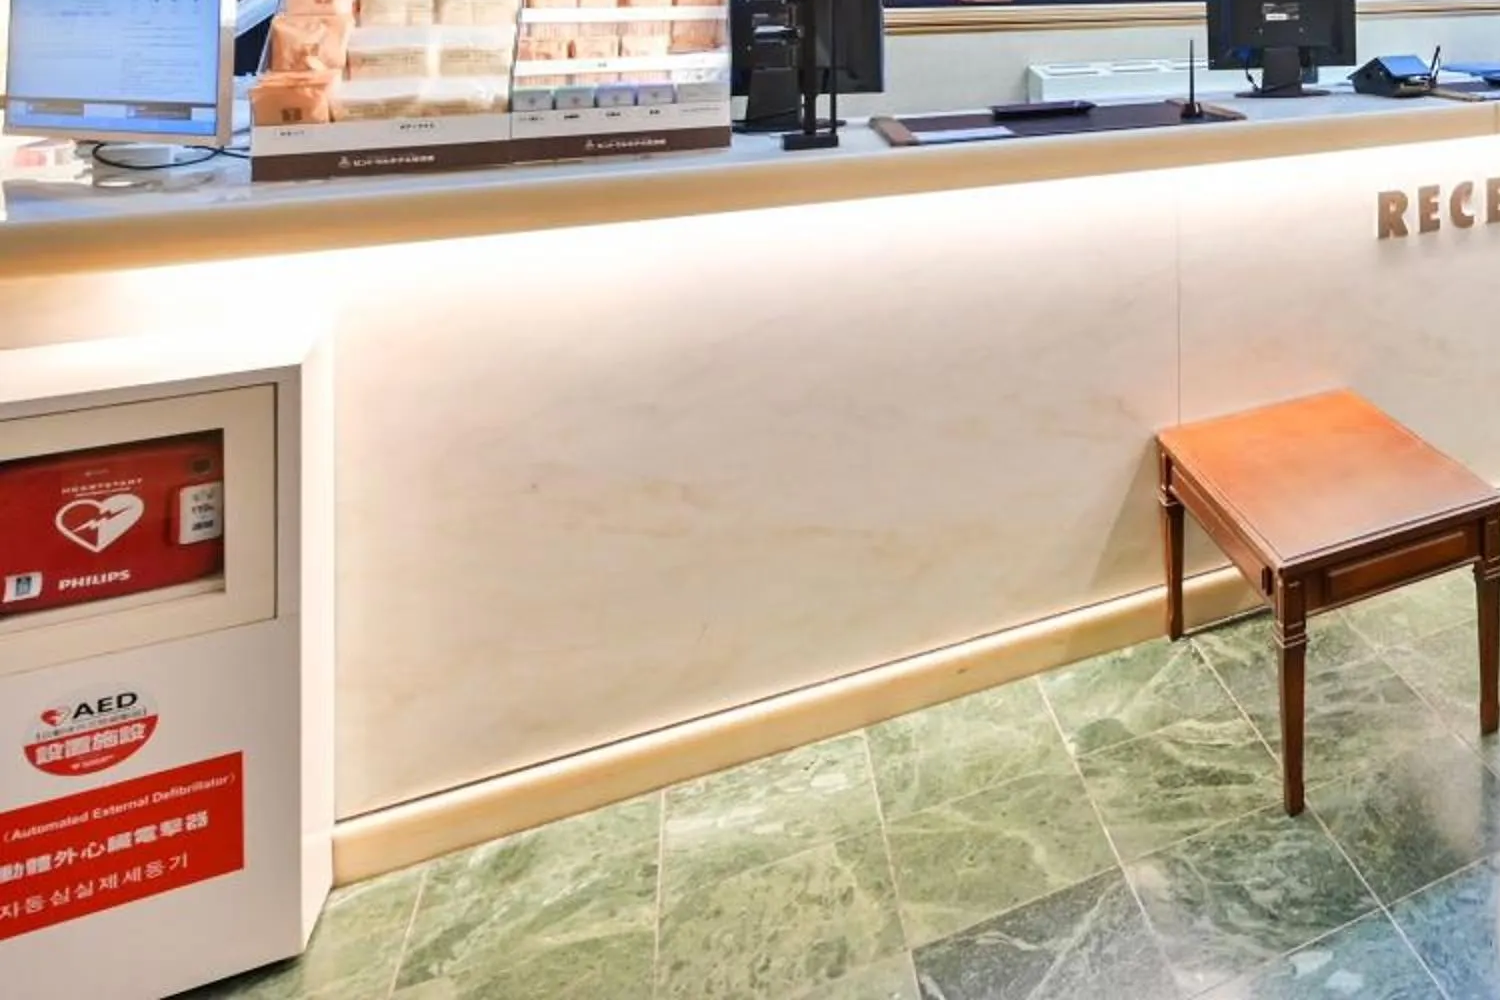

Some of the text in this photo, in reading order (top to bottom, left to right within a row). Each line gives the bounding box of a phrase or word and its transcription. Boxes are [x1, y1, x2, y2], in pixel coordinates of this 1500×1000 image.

[58, 570, 131, 591] PHILIPS
[72, 691, 138, 719] AED
[92, 797, 150, 820] External
